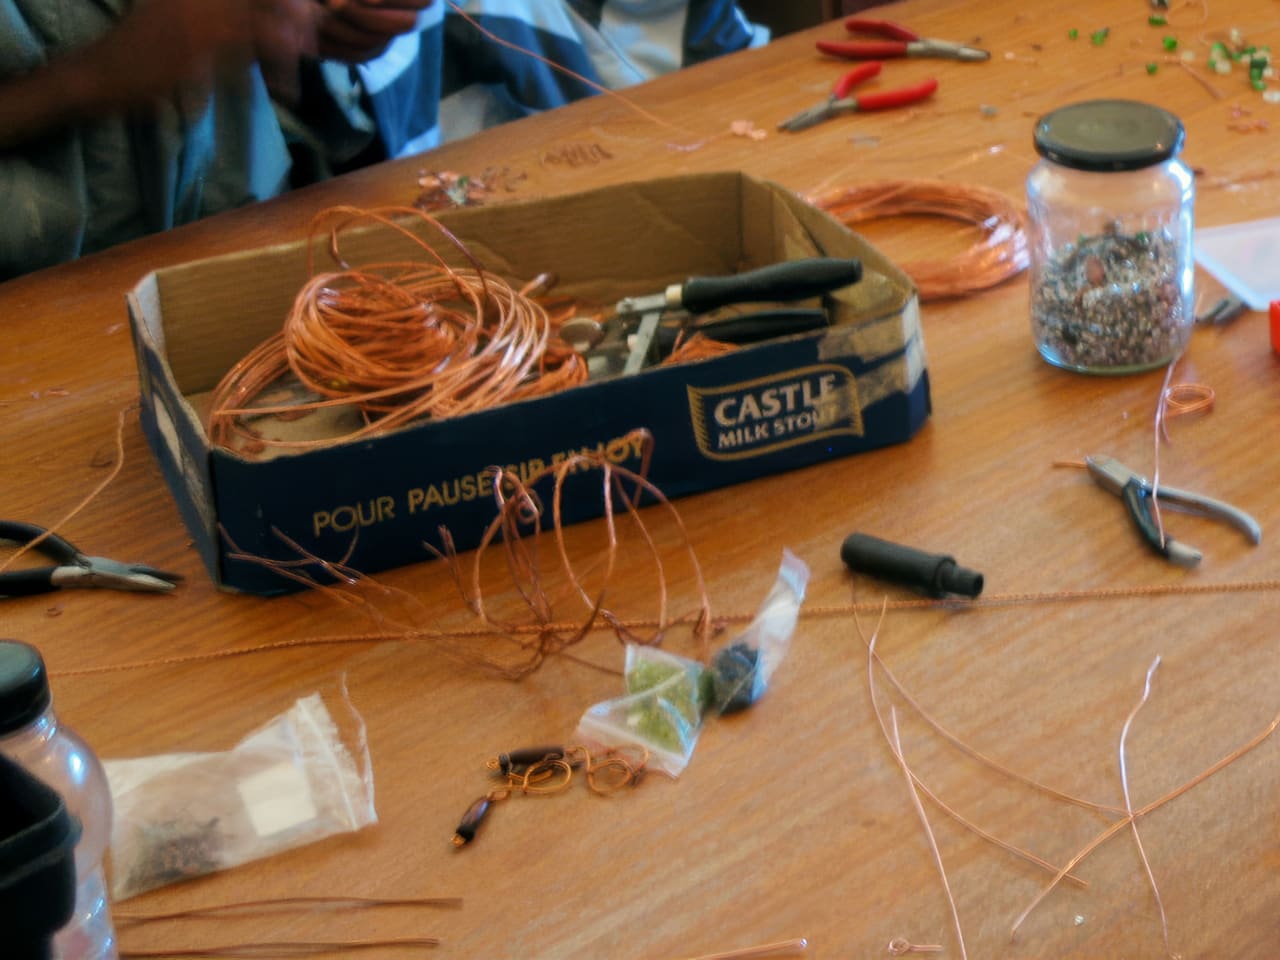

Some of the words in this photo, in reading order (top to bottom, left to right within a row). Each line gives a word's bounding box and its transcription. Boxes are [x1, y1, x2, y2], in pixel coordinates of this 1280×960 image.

[714, 372, 839, 426] CASTLE
[718, 422, 769, 449] MILK
[774, 402, 840, 436] STOUT
[313, 495, 396, 537] POUR
[408, 468, 497, 514] PAUSE
[551, 435, 645, 478] ENJOY
